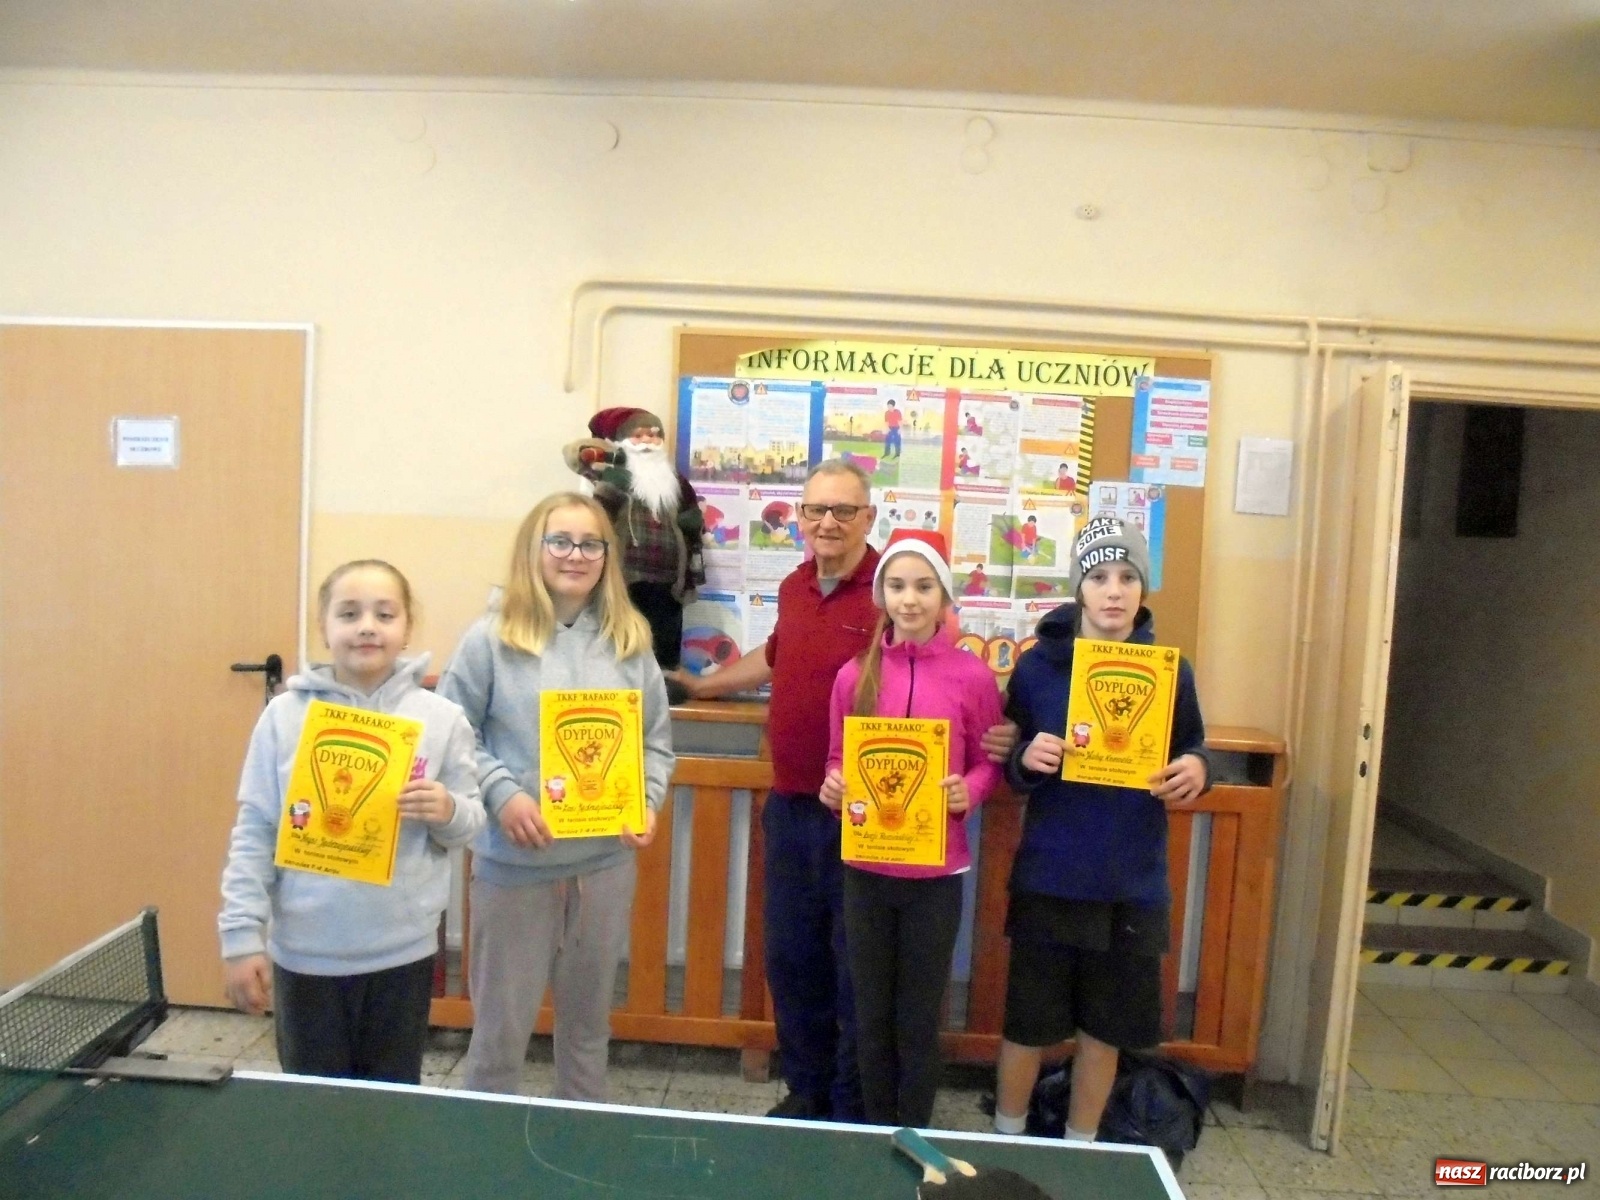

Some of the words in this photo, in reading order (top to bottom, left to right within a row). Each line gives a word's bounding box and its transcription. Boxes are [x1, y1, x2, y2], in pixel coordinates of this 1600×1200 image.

[747, 348, 935, 377] INFORMACJE
[950, 356, 1006, 380] DLA
[1017, 359, 1150, 388] UCZNIÓW
[1078, 526, 1117, 551] SOME
[1080, 547, 1126, 573] NOISE
[1091, 644, 1113, 654] TKKF
[1094, 680, 1149, 697] DYPLOM
[556, 693, 578, 701] TKKF
[323, 708, 348, 721] TKKF
[860, 722, 882, 730] TKKF
[563, 728, 615, 740] DYPLOM
[319, 749, 380, 774] DYPLOM
[865, 758, 920, 772] DYPLOM
